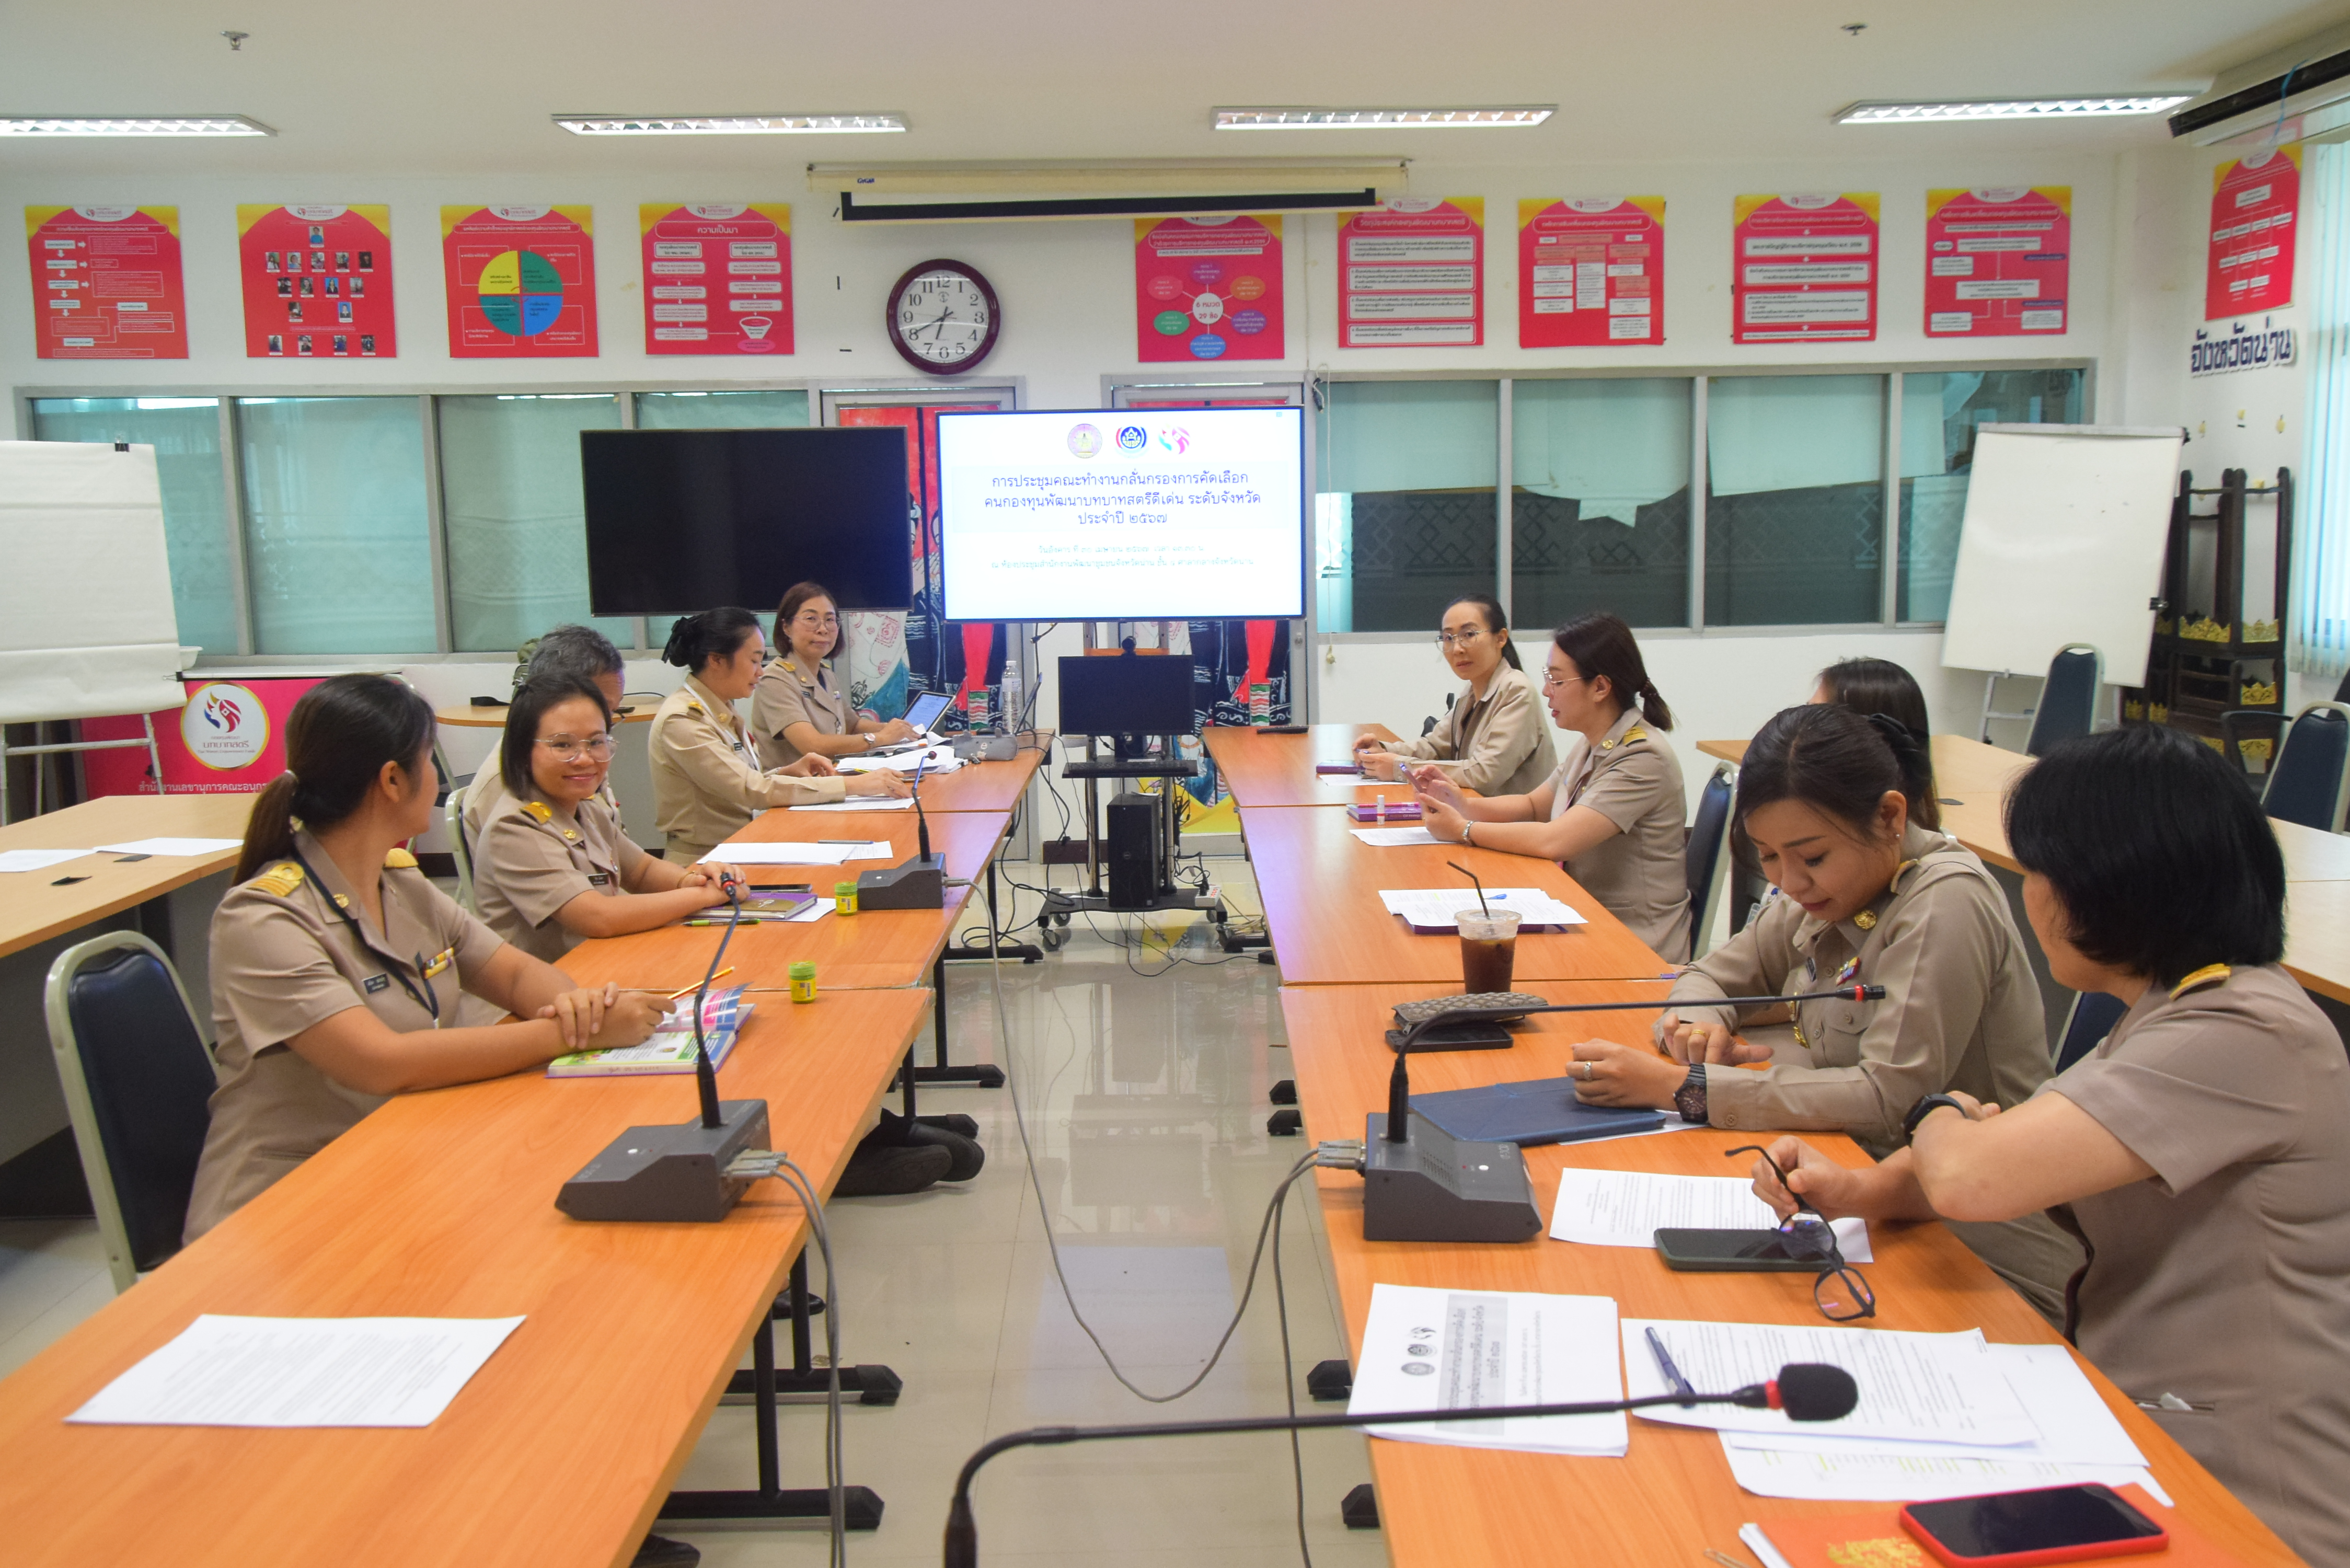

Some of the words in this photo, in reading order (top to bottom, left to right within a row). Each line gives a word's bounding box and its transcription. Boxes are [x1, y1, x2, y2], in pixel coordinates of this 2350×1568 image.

[697, 224, 738, 234] ความเป็นมา
[923, 281, 934, 293] 11
[936, 275, 951, 287] 12
[959, 281, 963, 293] 1
[909, 294, 922, 306] 10
[970, 294, 978, 306] 2
[903, 311, 913, 323] 9
[974, 311, 984, 324] 3
[908, 328, 919, 340] 8
[968, 329, 977, 341] 4
[924, 342, 933, 354] 7
[955, 342, 965, 354] 5
[2191, 315, 2291, 373] จังหวัดน่าน
[939, 347, 949, 359] 6
[992, 468, 1248, 491] การประชุมคณะทำงานกลั่นกรองการคัดเลือก
[985, 491, 1184, 511] คนกองทุนพัฒนาบทบาทสตรีดีเด่น
[1188, 490, 1261, 504] ระดับจังหวัด
[1078, 510, 1124, 524] ประจำปี
[1129, 513, 1167, 524] ๒๕๖๗
[203, 740, 249, 748] บทบาทสตรี
